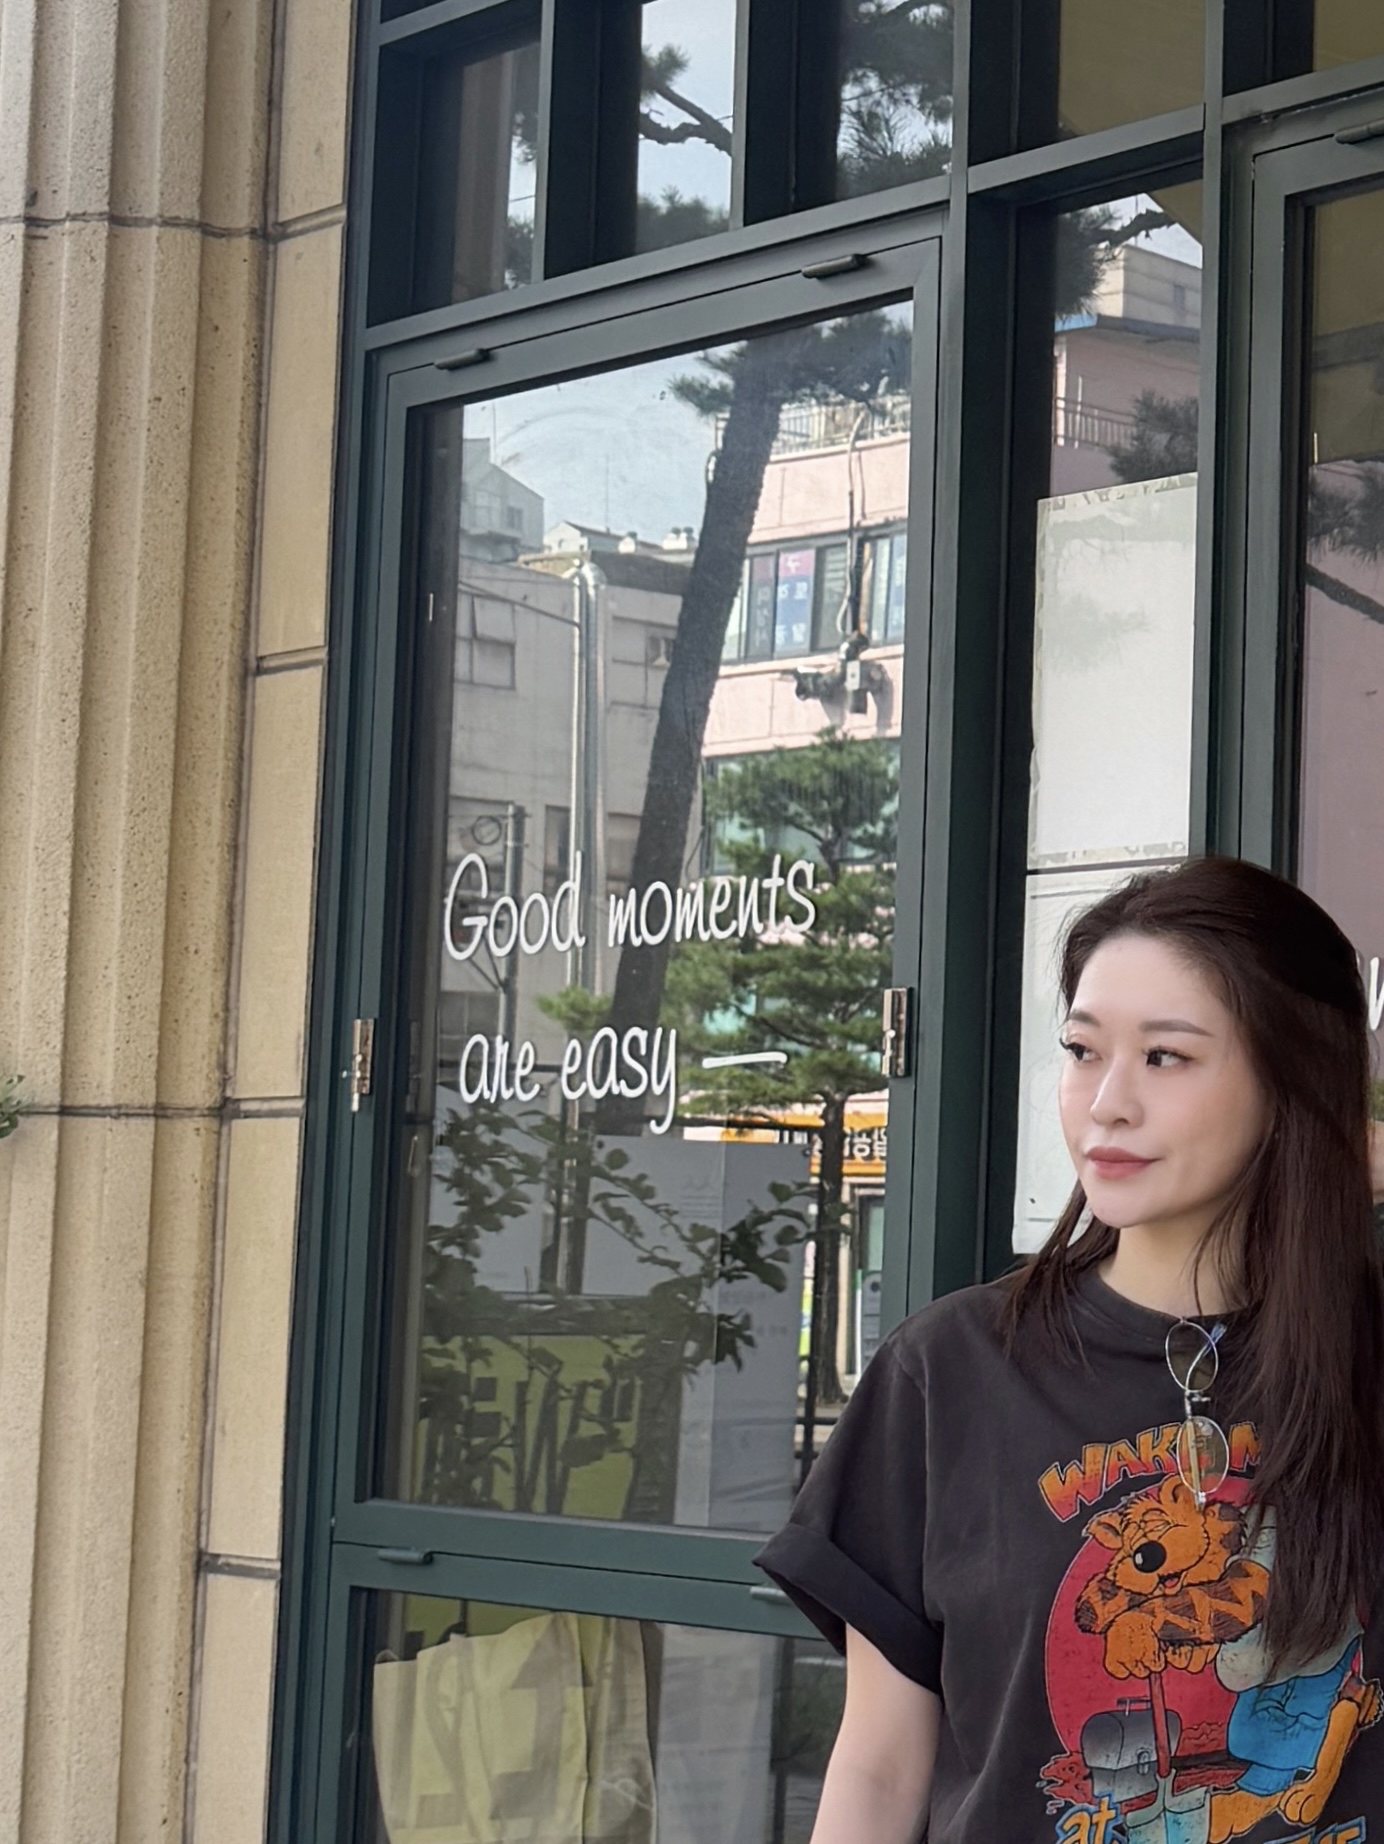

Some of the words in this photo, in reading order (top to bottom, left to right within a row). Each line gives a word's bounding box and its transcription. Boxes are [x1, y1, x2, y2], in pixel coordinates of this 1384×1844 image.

[443, 850, 586, 961] Good
[607, 853, 818, 948] moments
[458, 1031, 541, 1104] are
[560, 1026, 678, 1135] easy
